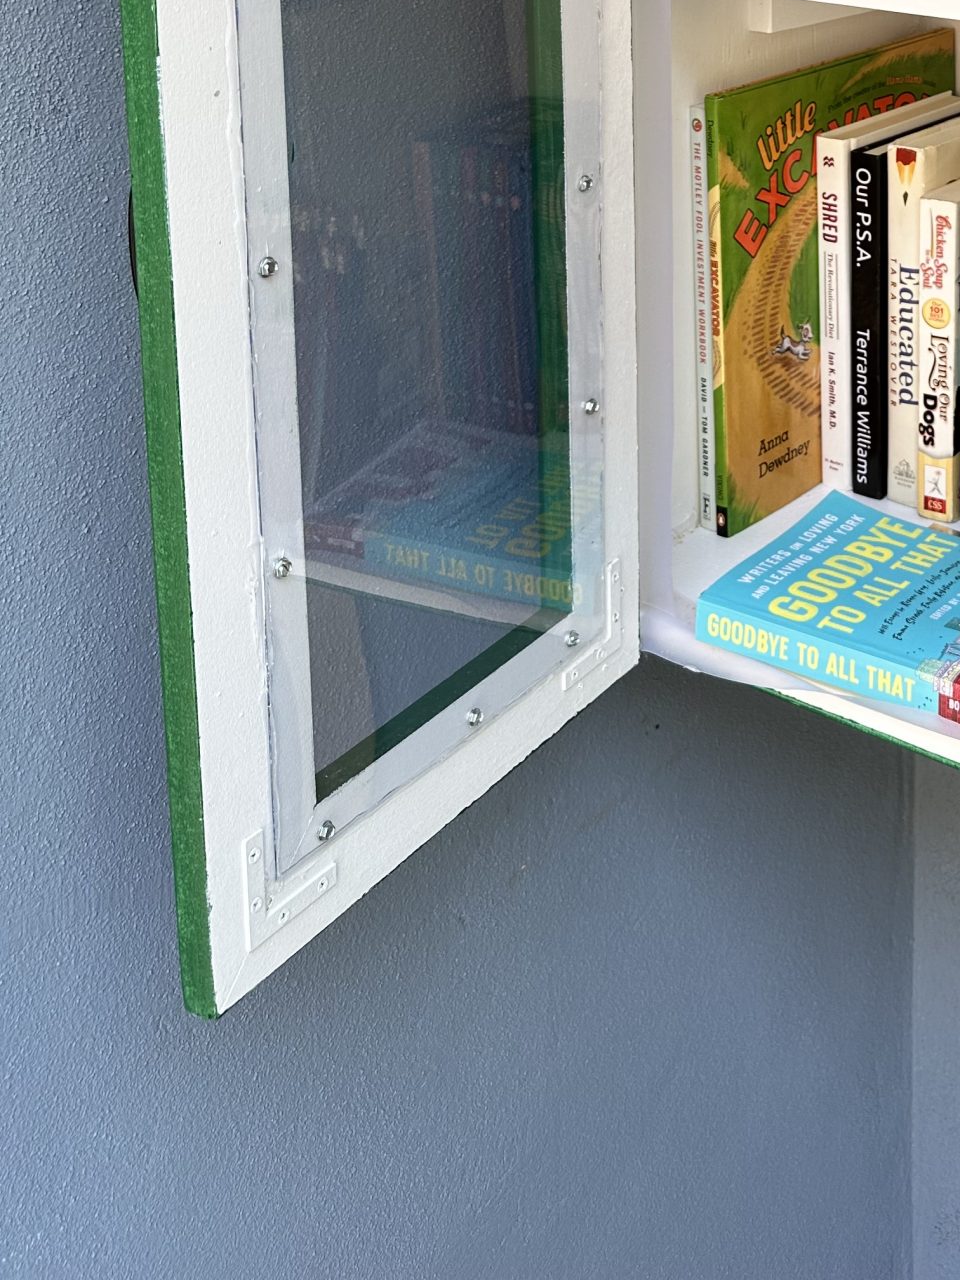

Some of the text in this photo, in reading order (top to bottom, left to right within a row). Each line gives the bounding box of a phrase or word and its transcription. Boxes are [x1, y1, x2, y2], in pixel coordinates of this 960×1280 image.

[756, 100, 816, 171] little
[696, 210, 704, 234] FOOL
[822, 192, 838, 244] SHRED
[855, 168, 872, 267] Our P.S.A.
[697, 239, 705, 304] INVESTMENT
[827, 253, 835, 267] The
[920, 262, 934, 289] Soul
[934, 214, 952, 290] Chicken Soup
[710, 260, 721, 336] EXCAVATOR
[699, 309, 707, 365] WORKBOOK
[828, 351, 836, 366] Ian
[889, 315, 897, 407] WESTOVER
[898, 263, 919, 405] Educated
[930, 332, 949, 389] Loving
[829, 409, 837, 429] M.D.
[856, 329, 872, 484] Terrance Williams
[918, 393, 938, 448] Dogs
[939, 392, 949, 422] Our
[758, 430, 789, 456] Anna
[759, 440, 810, 479] Dewdney
[927, 499, 943, 510] CSS
[737, 513, 839, 584] WRITERS ON LOVING
[751, 514, 866, 600] AND LEAVING NEW YORK
[767, 517, 924, 623] GOODBYE
[817, 604, 866, 634] TO
[853, 576, 911, 607] ALL
[890, 533, 960, 575] THAT
[706, 612, 916, 703] GOODBYE TO ALL THAT
